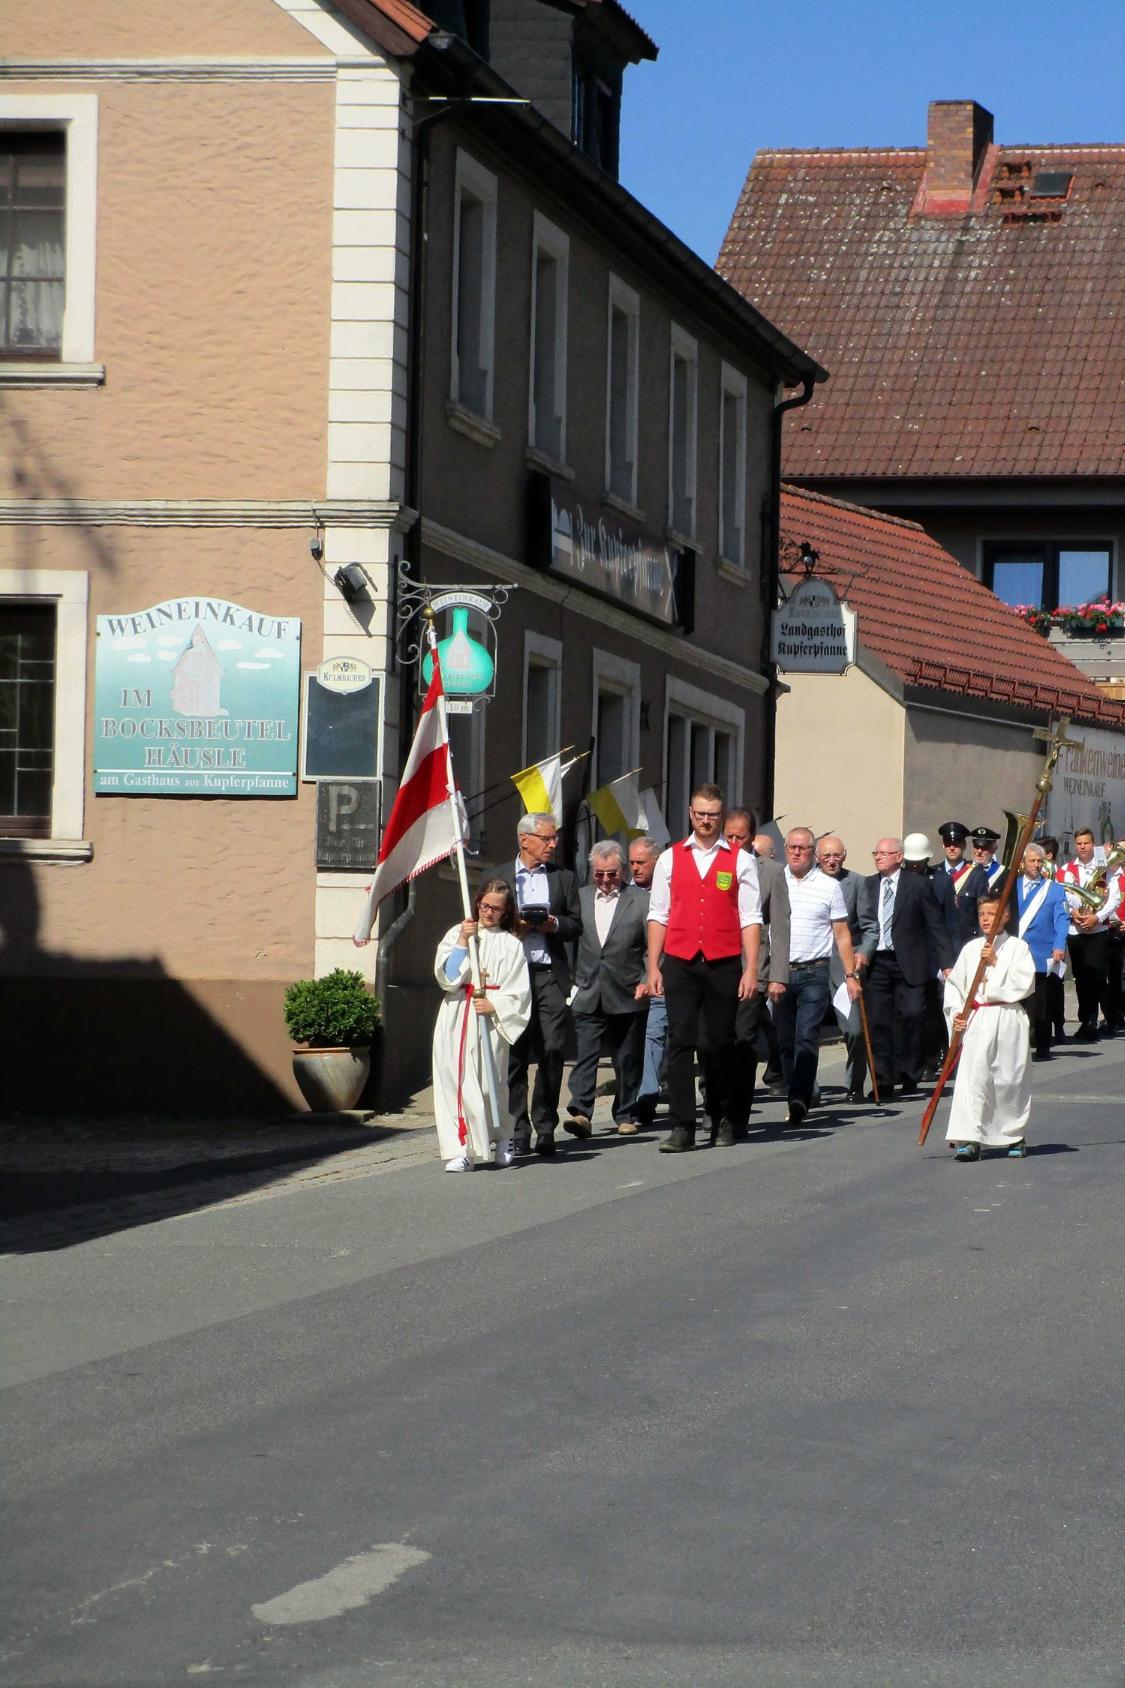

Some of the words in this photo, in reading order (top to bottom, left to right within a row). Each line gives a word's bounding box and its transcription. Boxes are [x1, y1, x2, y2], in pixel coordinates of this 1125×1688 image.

[107, 600, 289, 640] WEINEINKAUF
[780, 622, 847, 641] Landgasthof
[777, 640, 848, 660] Kupferpfanne
[120, 687, 153, 709] IM
[101, 717, 292, 742] BOCKSBEUTEL
[143, 742, 247, 769] HÄUSLE
[99, 777, 119, 786] am
[123, 773, 181, 787] Gasthaus
[184, 779, 201, 788] zur
[203, 774, 290, 792] Kupferpfanne
[1063, 777, 1107, 798] WEINEINKAUF
[328, 785, 361, 833] P
